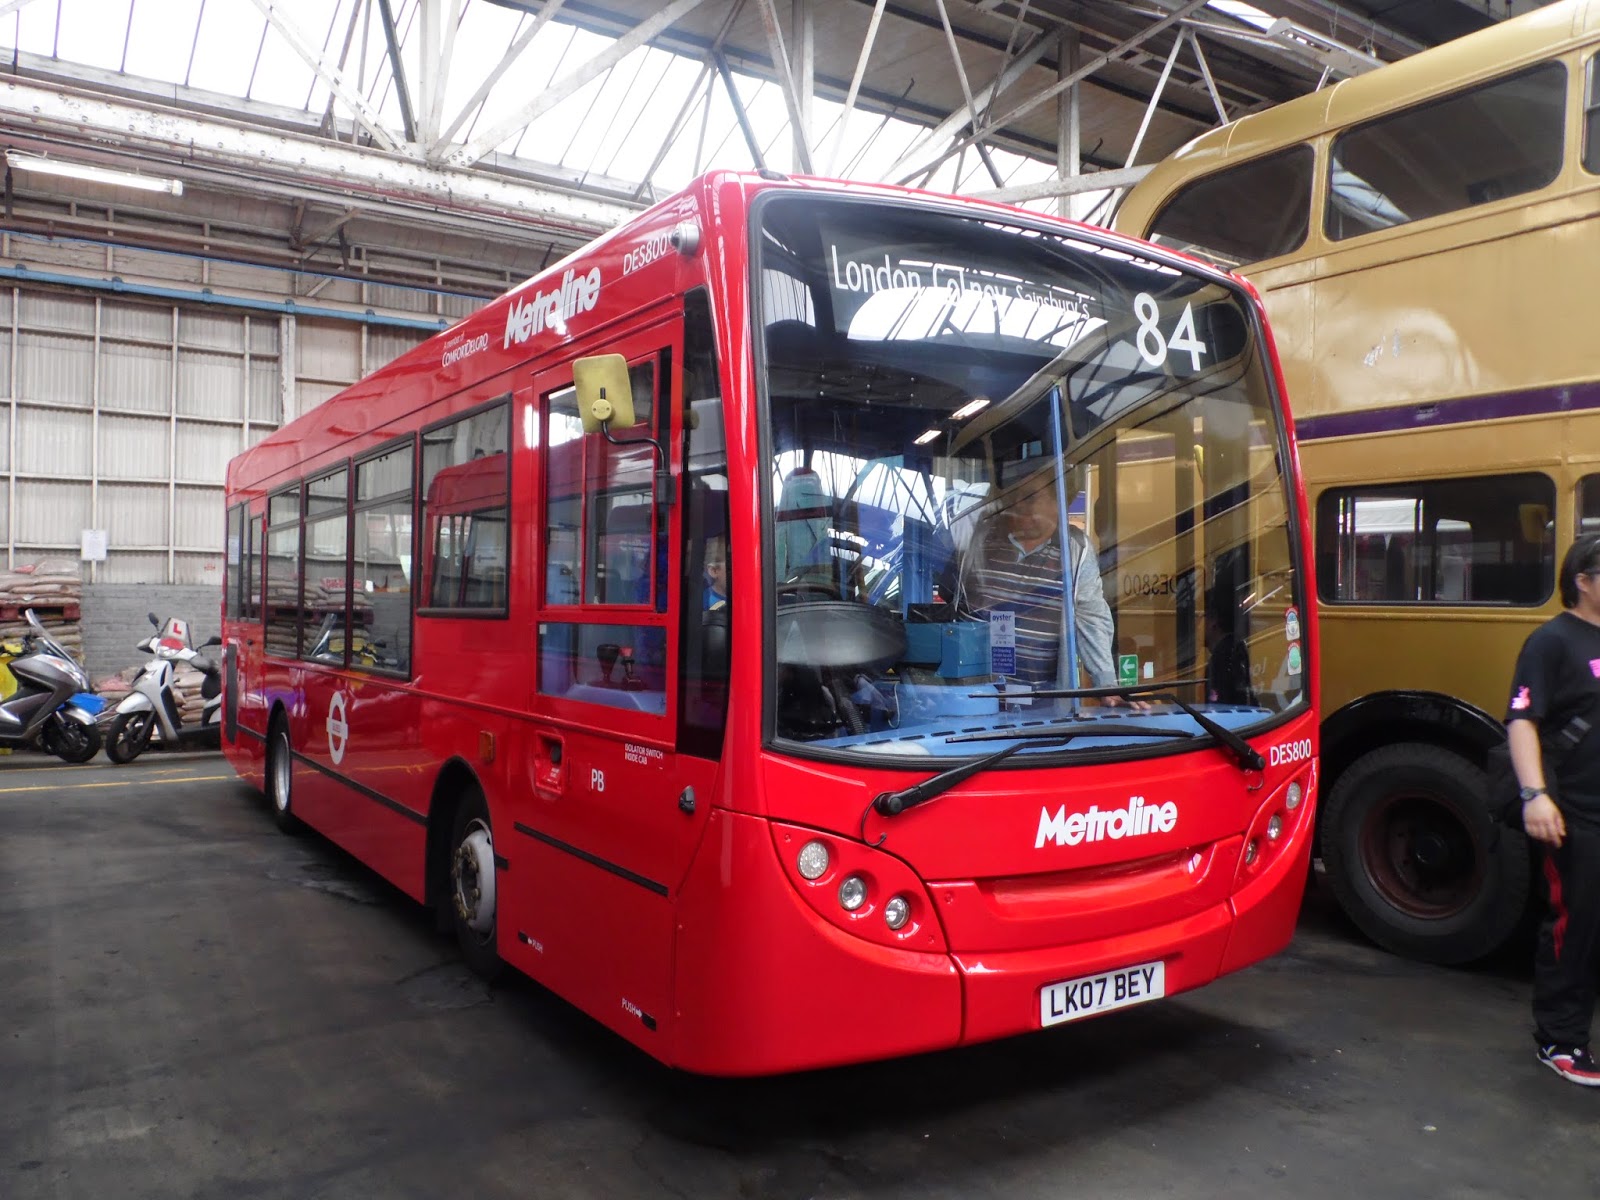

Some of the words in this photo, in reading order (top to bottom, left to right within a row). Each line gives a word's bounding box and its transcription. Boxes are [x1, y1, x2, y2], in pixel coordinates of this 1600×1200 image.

[623, 232, 668, 276] DES800
[831, 244, 921, 294] London
[1015, 284, 1090, 323] Sainsbury's
[503, 266, 601, 350] Metroline
[1133, 291, 1207, 372] 84
[173, 623, 182, 634] L
[992, 613, 1012, 623] oyster
[625, 743, 645, 755] ISOLATOR
[646, 747, 663, 759] SWITCH
[638, 755, 648, 765] CAB
[1270, 737, 1312, 767] DES800
[591, 768, 605, 792] PB
[1034, 796, 1178, 849] Metroline
[532, 939, 543, 954] PUSH
[1050, 977, 1108, 1018] LK07
[1114, 966, 1156, 1002] BEY
[621, 997, 636, 1015] PUSH
